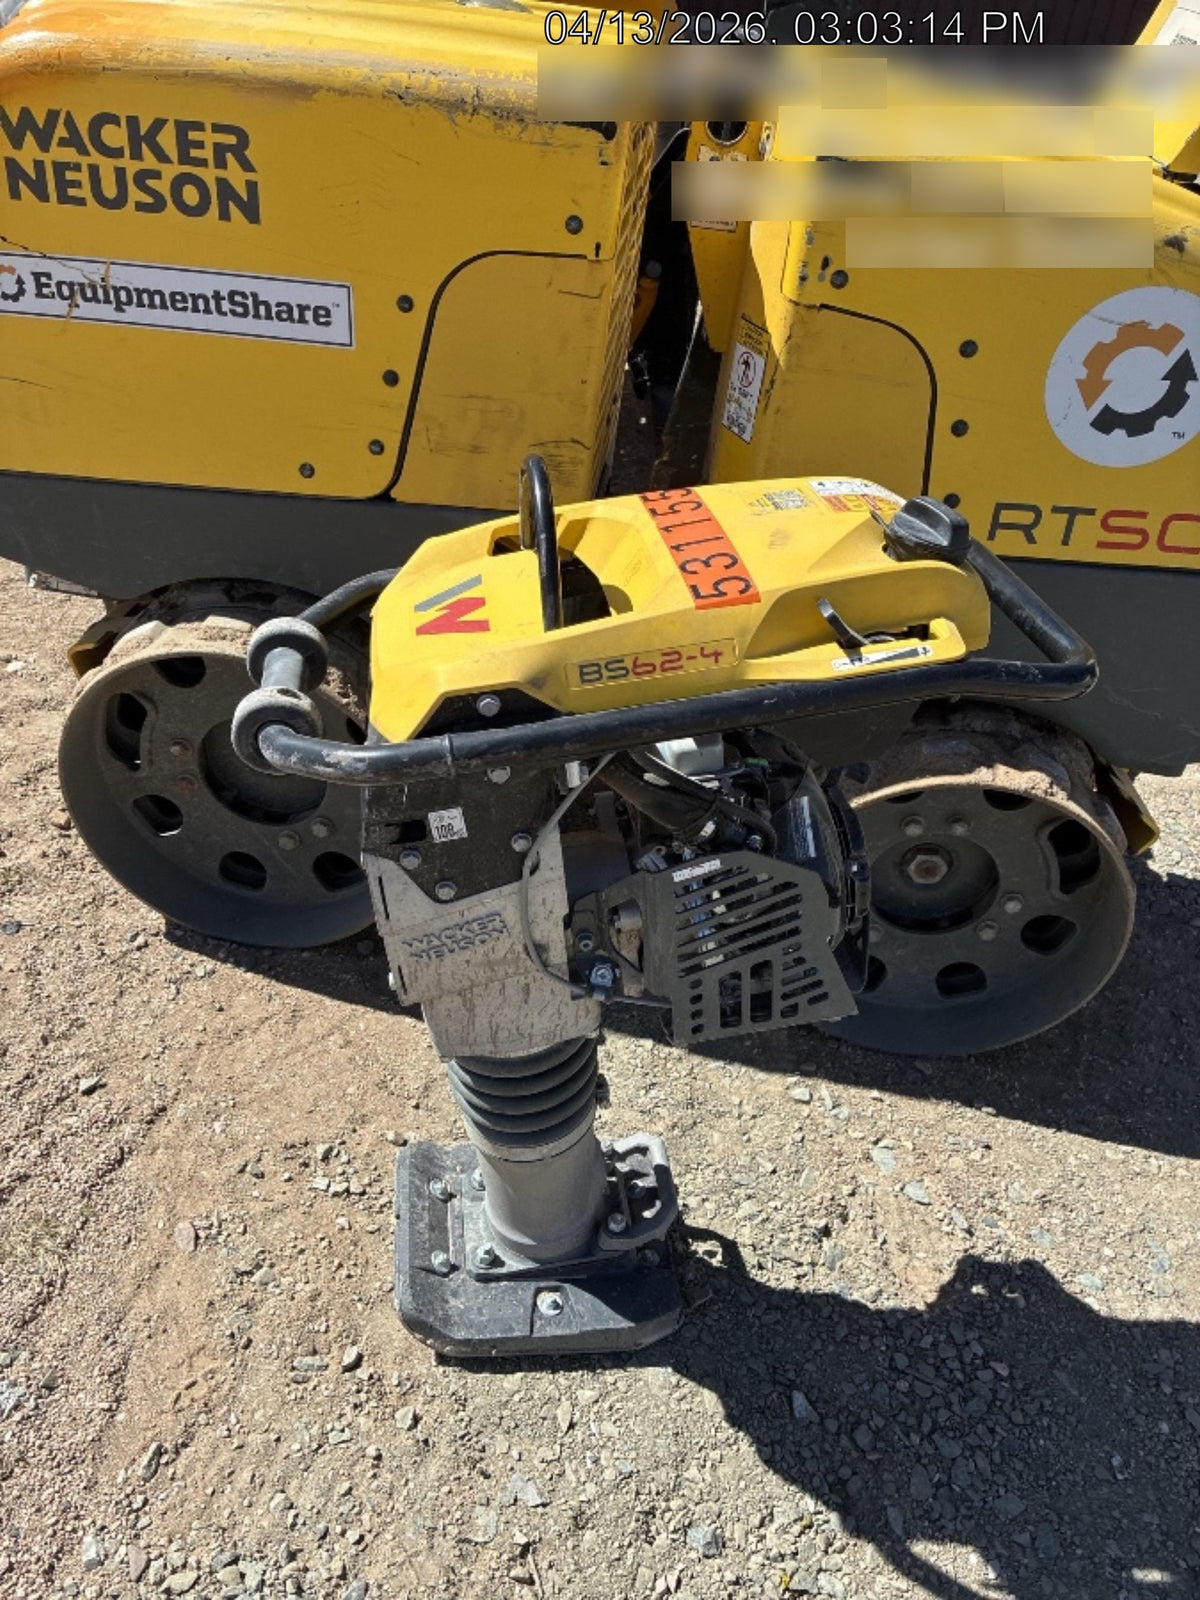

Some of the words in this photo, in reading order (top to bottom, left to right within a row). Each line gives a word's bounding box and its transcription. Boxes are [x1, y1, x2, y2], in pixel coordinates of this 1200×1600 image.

[0, 106, 257, 173] WACKER
[4, 156, 261, 225] NEUSON
[578, 646, 724, 684] BS62-4
